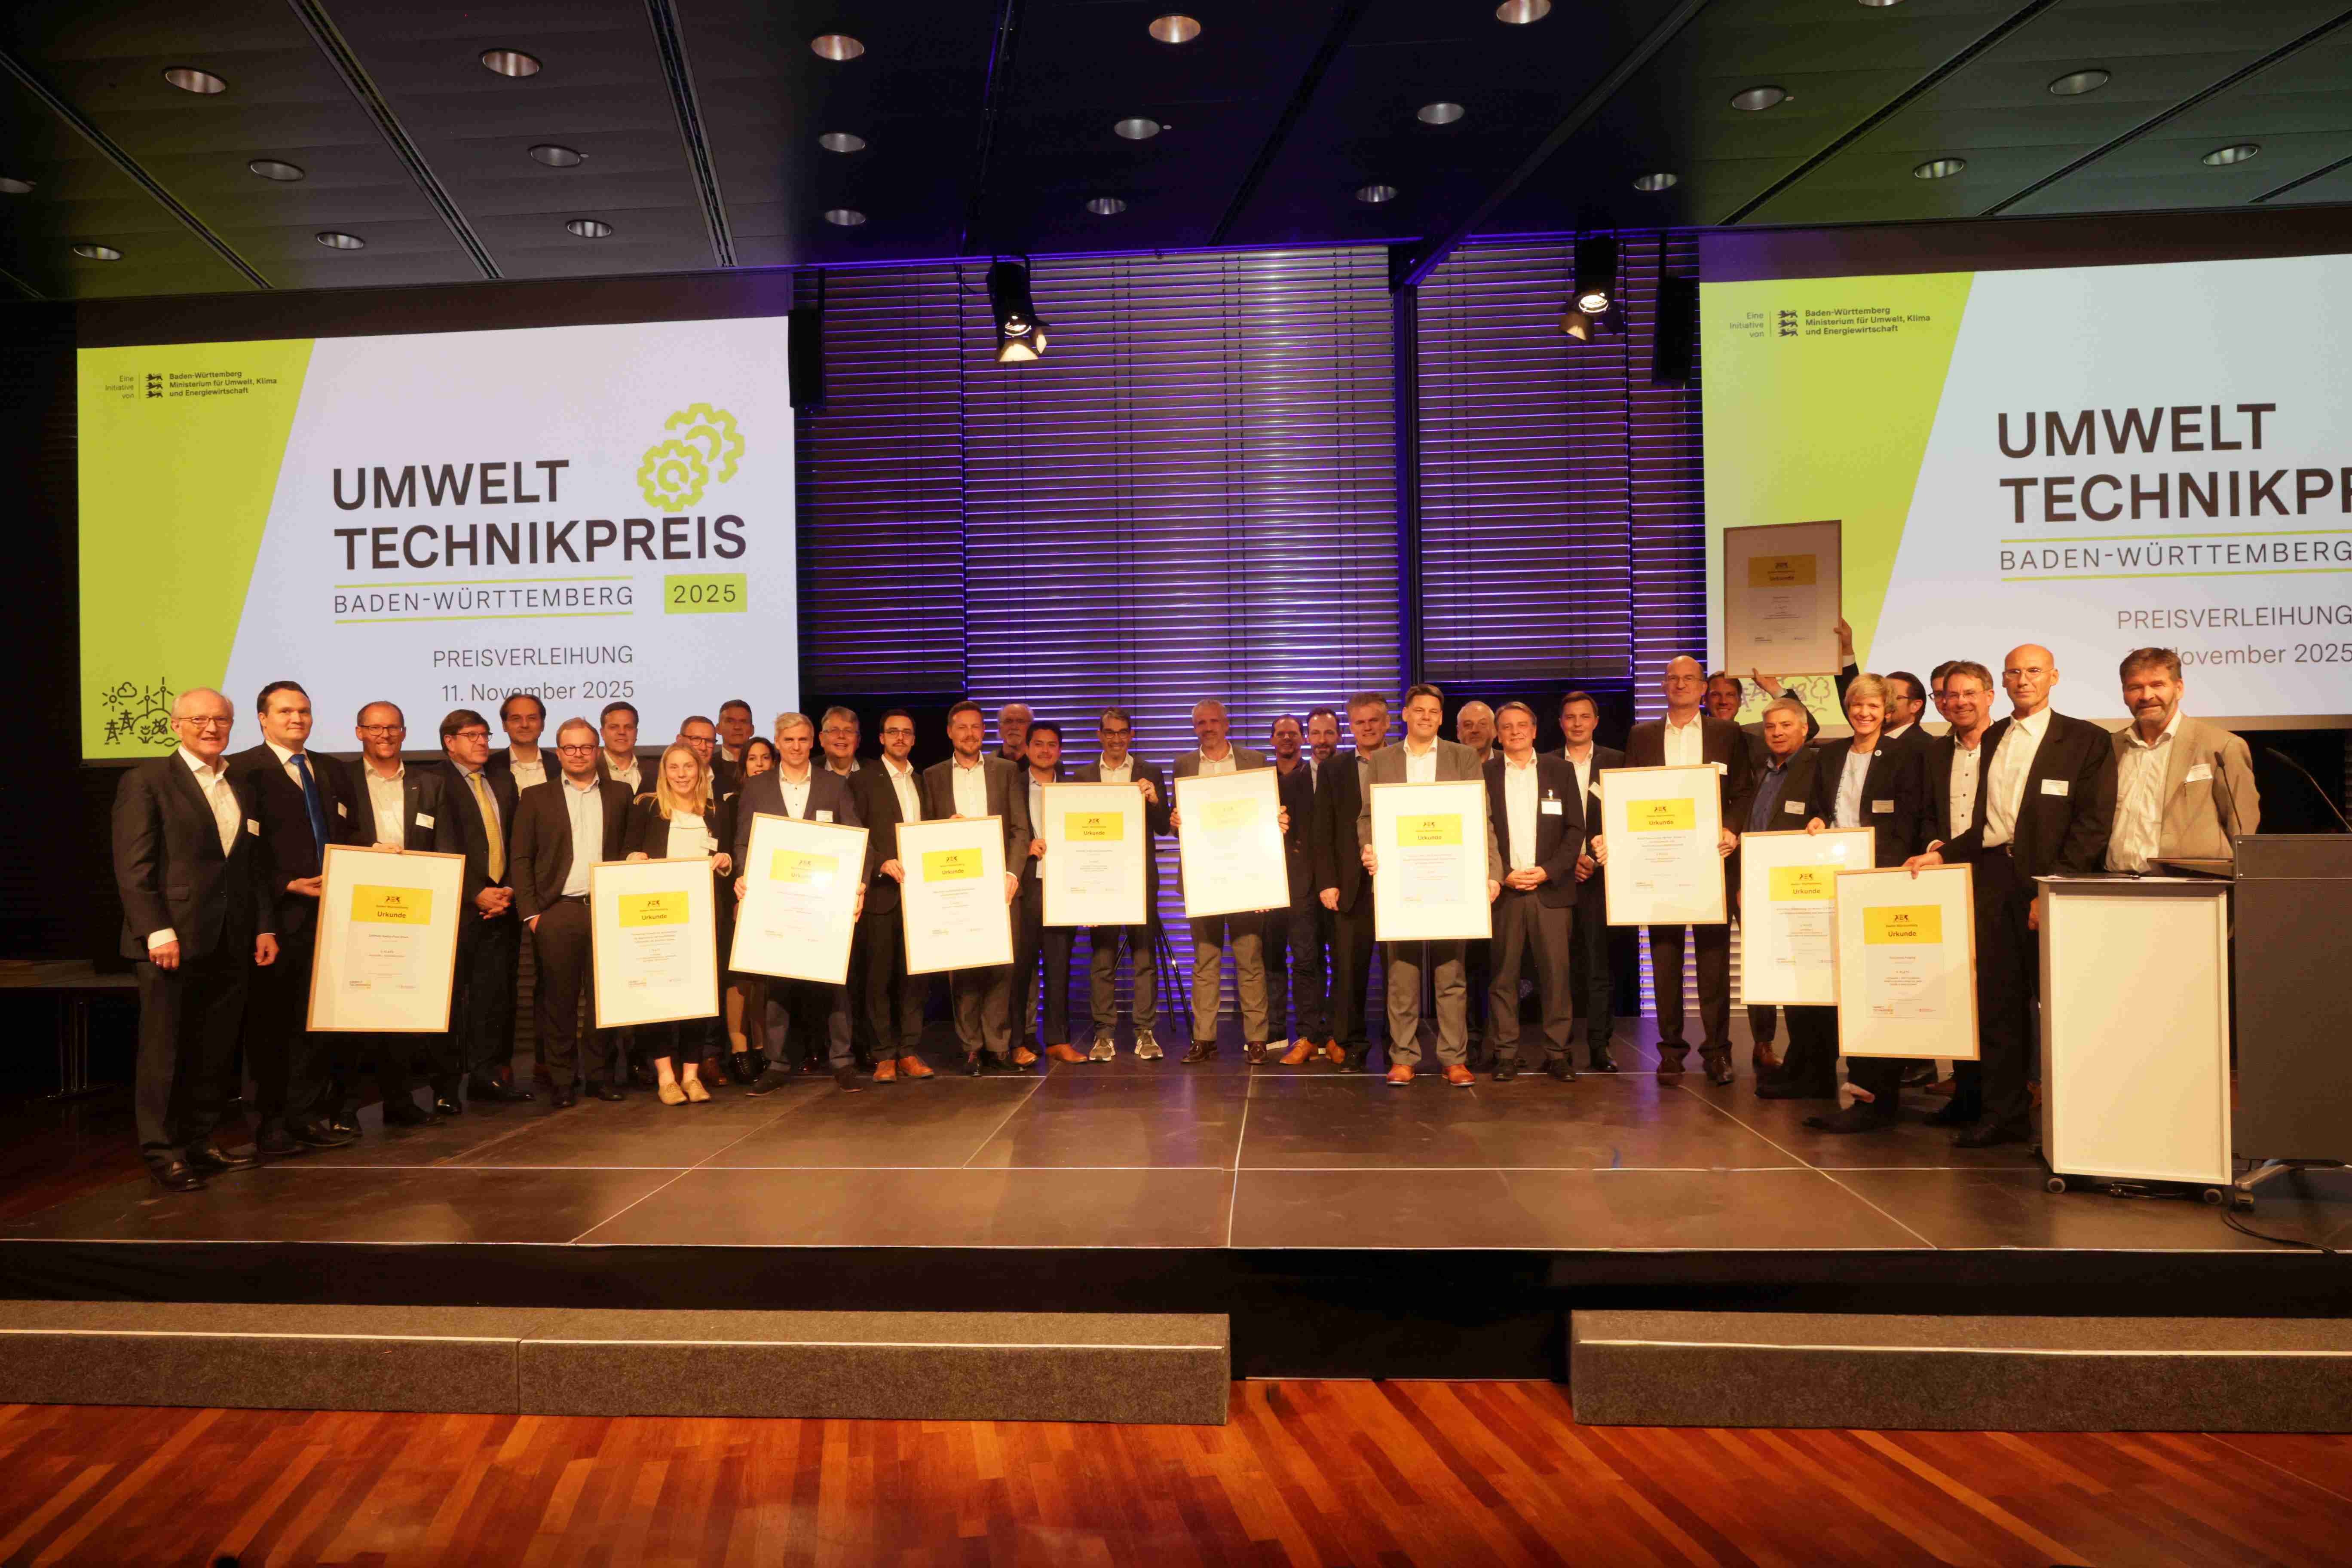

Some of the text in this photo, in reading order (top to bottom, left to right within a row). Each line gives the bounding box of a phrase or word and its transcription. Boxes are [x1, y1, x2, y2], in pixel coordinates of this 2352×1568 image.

[1805, 307, 1890, 317] Baden-Württemberg
[1824, 325, 1898, 336] Energiewirtschaft
[169, 371, 242, 380] Baden-Württemberg
[185, 387, 248, 397] Energiewirtschaft
[1998, 403, 2276, 458] UMWELT
[333, 459, 569, 510] UMWELT
[334, 514, 746, 570] TECHNIKPREIS
[2001, 541, 2352, 570] BADEN-WÜRTTEMBERG
[335, 586, 633, 614] BADEN-WÜRTTEMBERG
[674, 584, 736, 604] 2025
[2118, 605, 2352, 629] PREISVERLEIHUNG
[434, 645, 633, 668] PREISVERLEIHUNG
[2295, 643, 2352, 662] 2025
[442, 680, 634, 701] 11. November 2025
